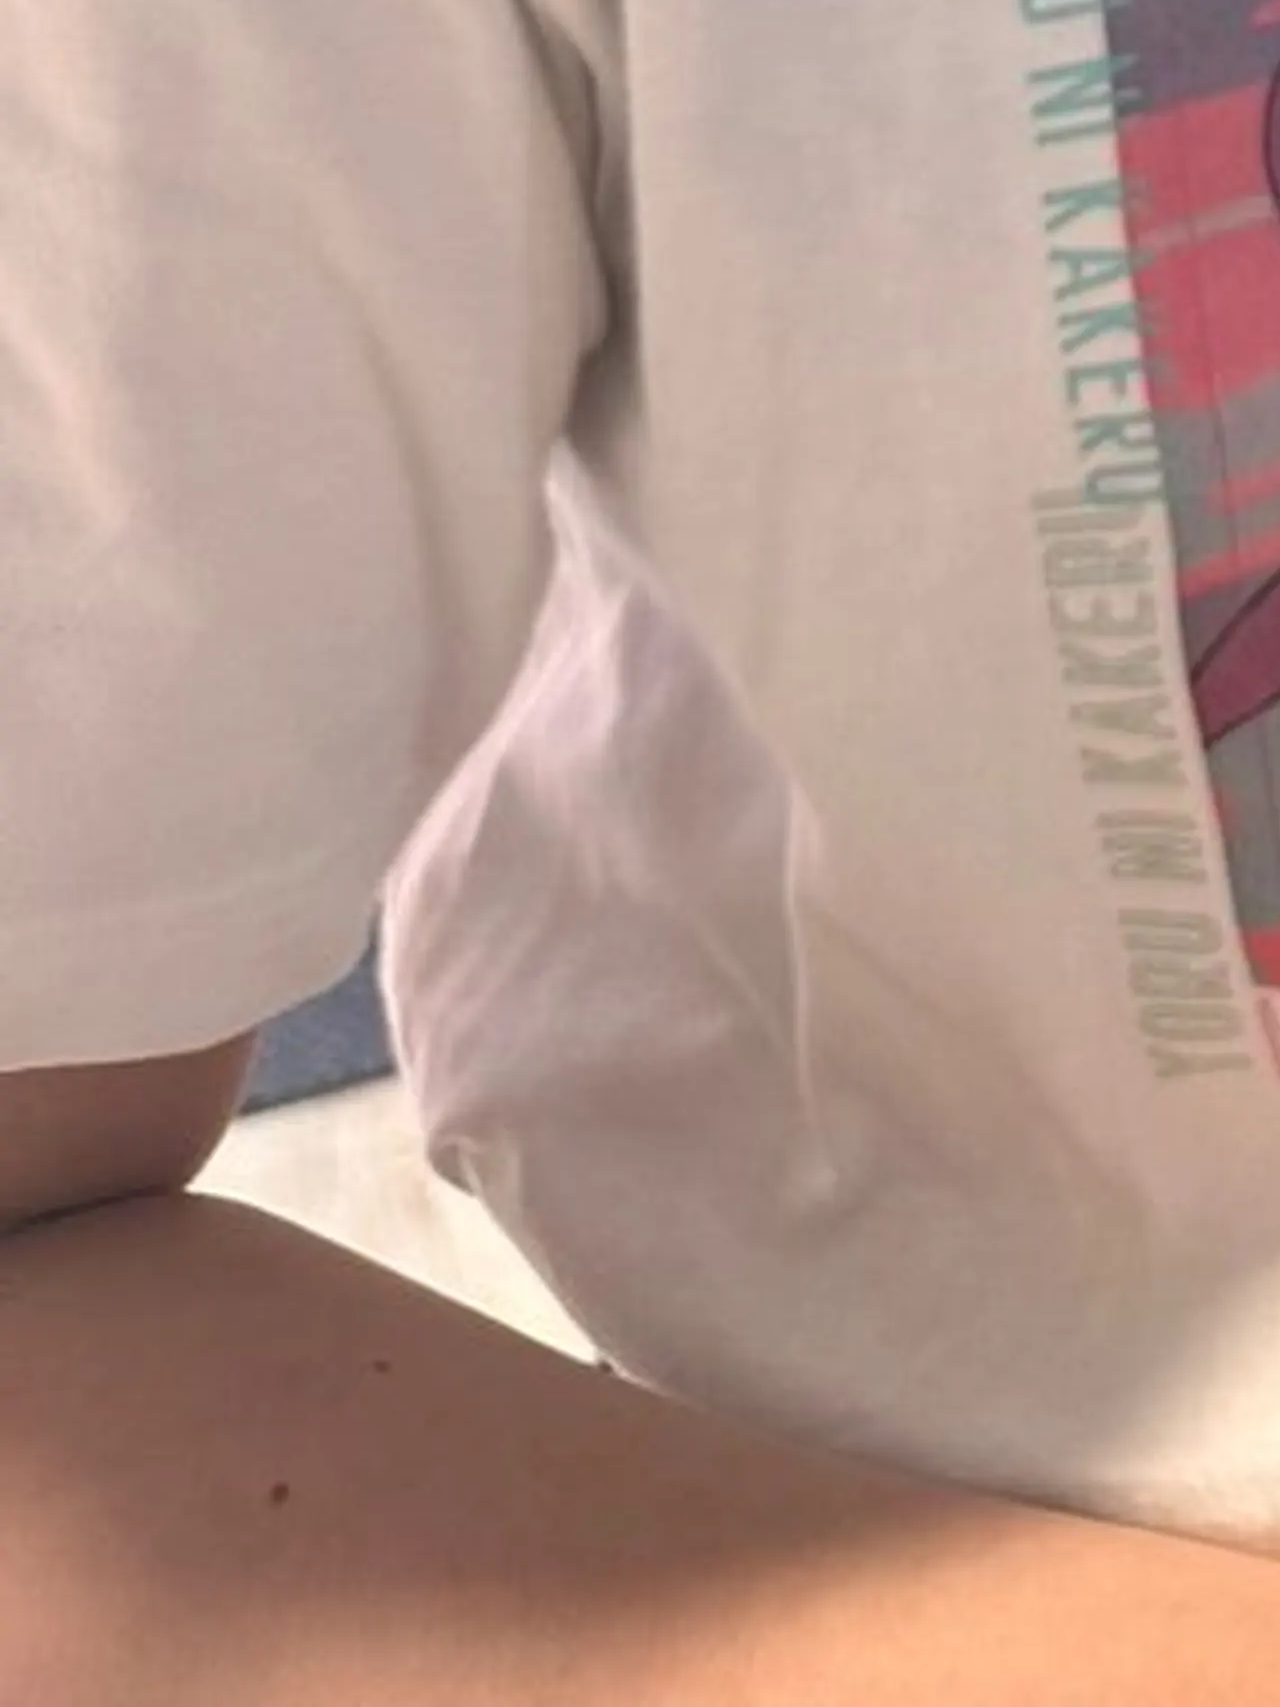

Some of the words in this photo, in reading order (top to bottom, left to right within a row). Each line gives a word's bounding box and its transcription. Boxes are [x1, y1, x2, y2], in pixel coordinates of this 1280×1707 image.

[1023, 53, 1148, 144] NI
[1043, 174, 1180, 507] KAKERU
[1033, 491, 1190, 784] KAKERU
[1096, 810, 1207, 884] NI
[1120, 908, 1255, 1077] YORU
